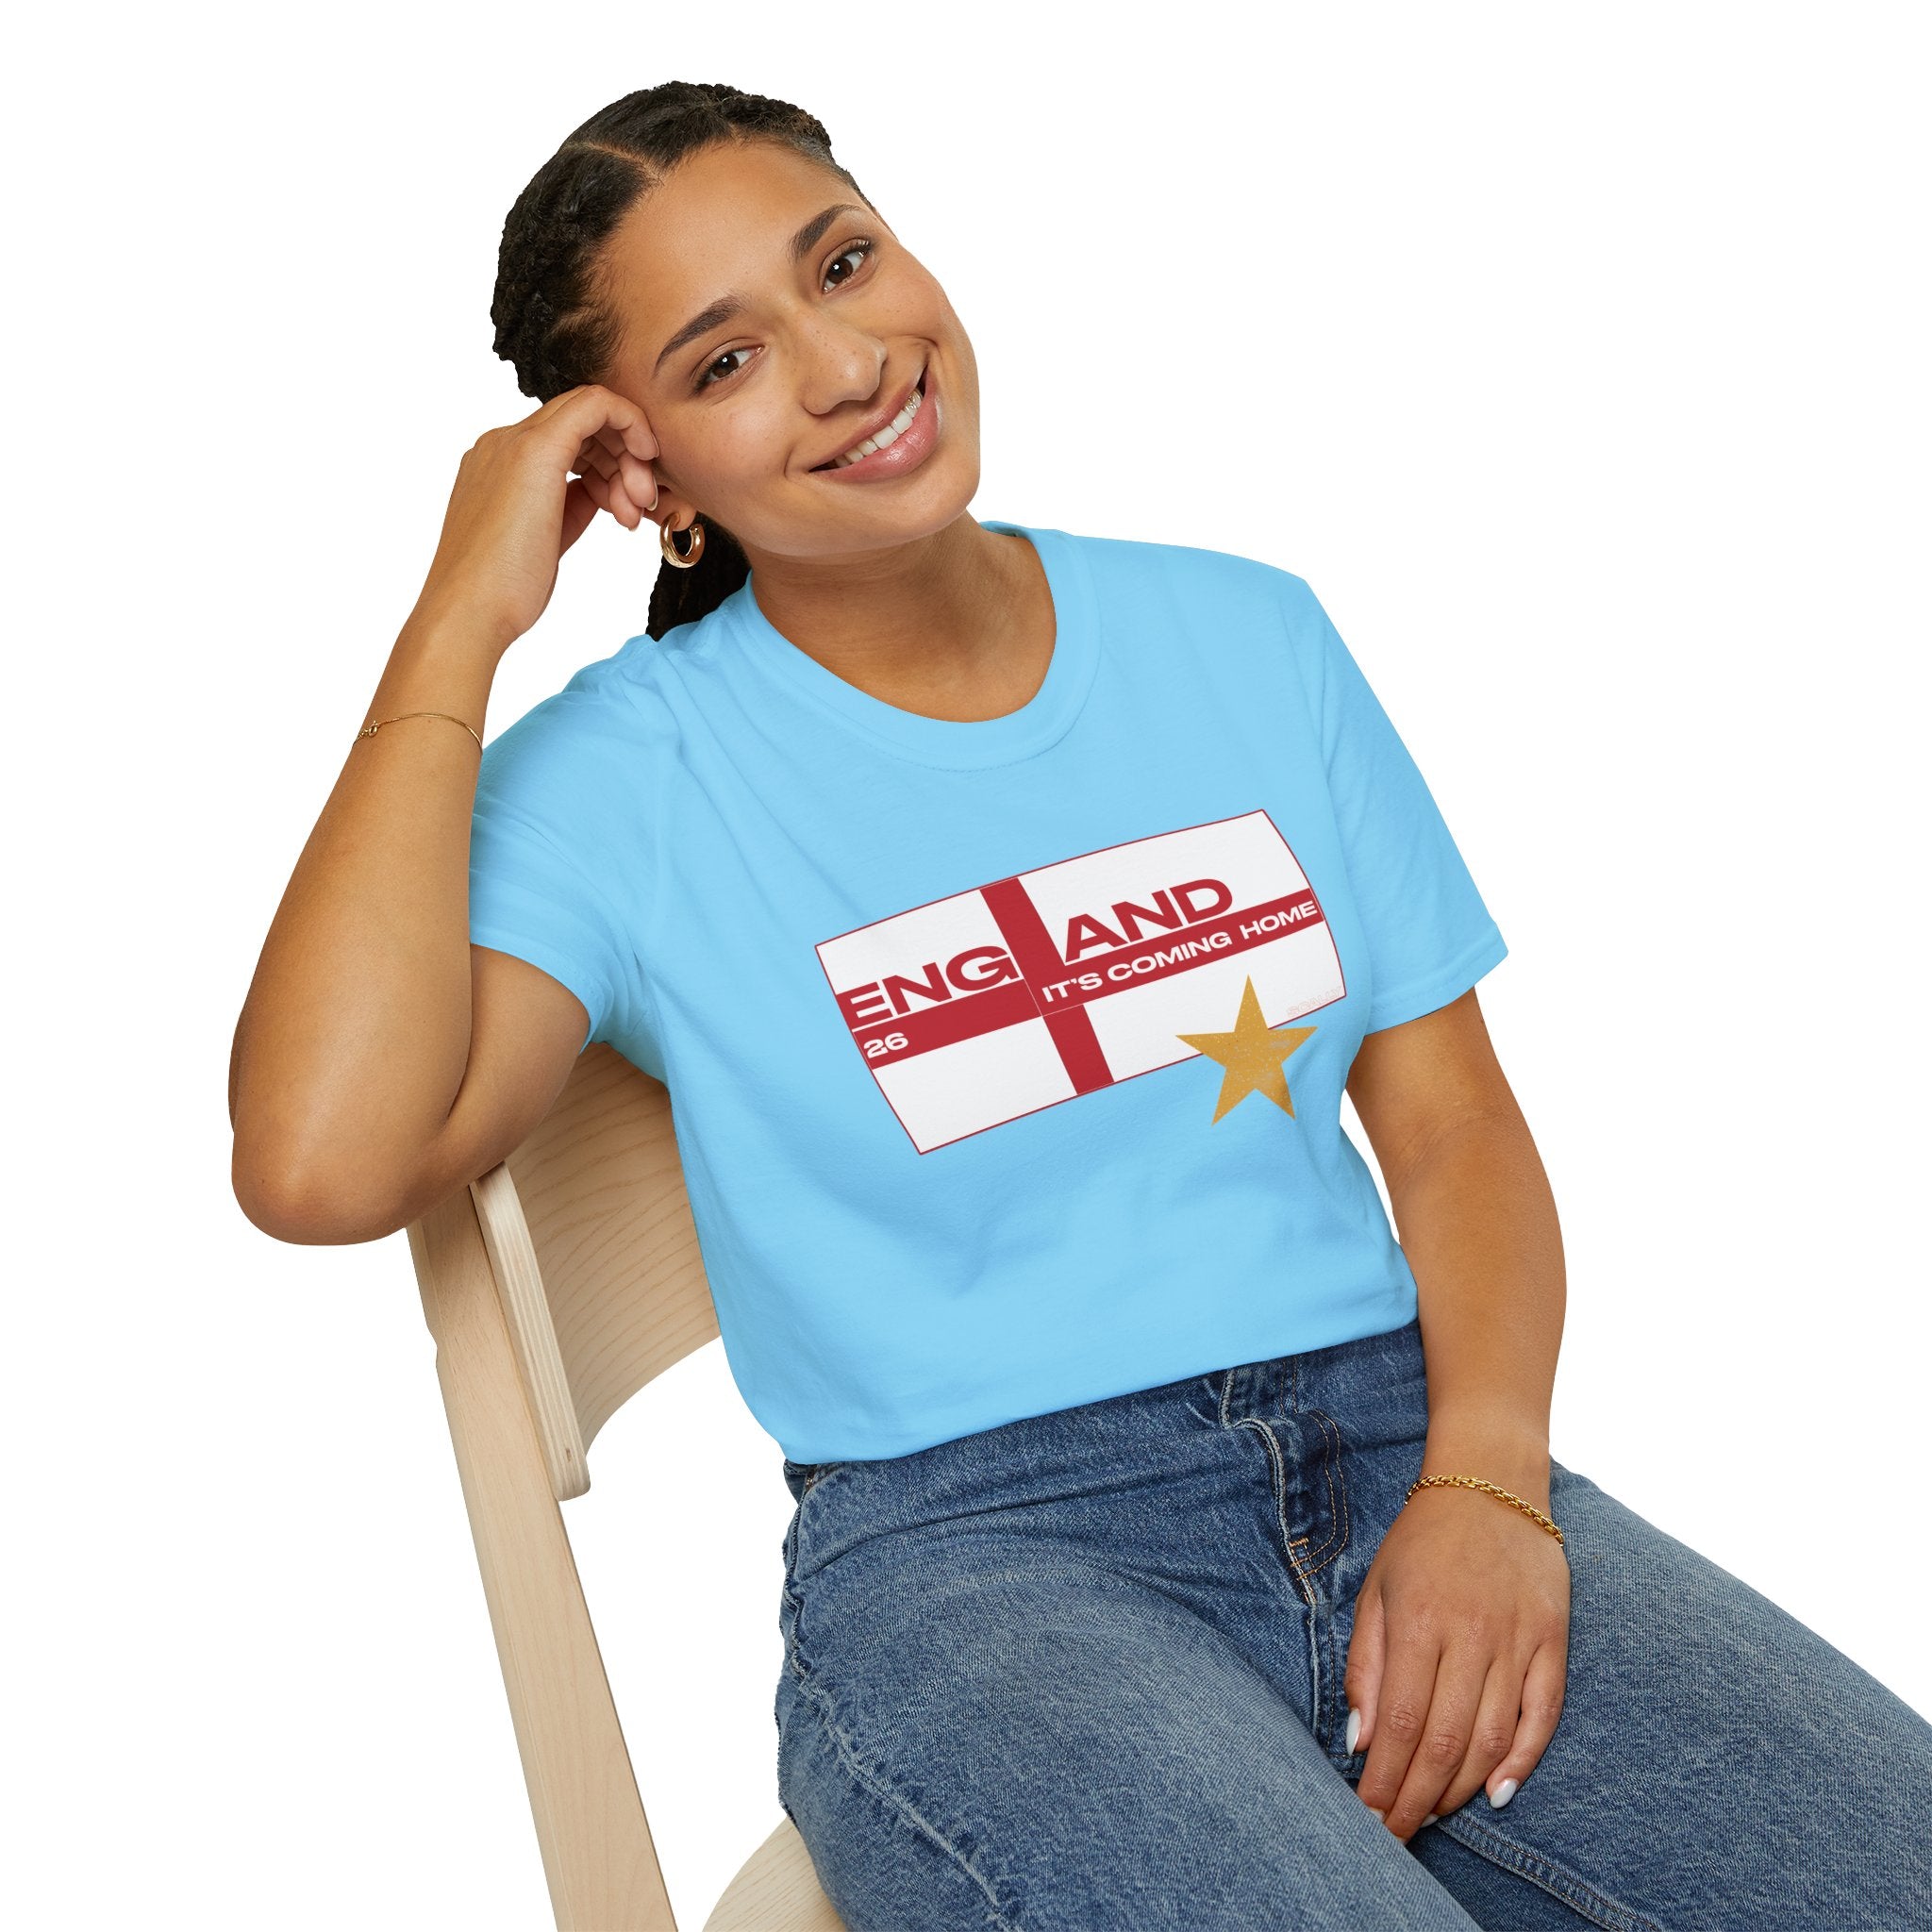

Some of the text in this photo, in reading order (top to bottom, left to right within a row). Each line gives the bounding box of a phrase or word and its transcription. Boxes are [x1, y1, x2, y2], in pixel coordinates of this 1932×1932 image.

[1041, 900, 1318, 1003] IT'S COMING HOME
[863, 1032, 909, 1058] 26
